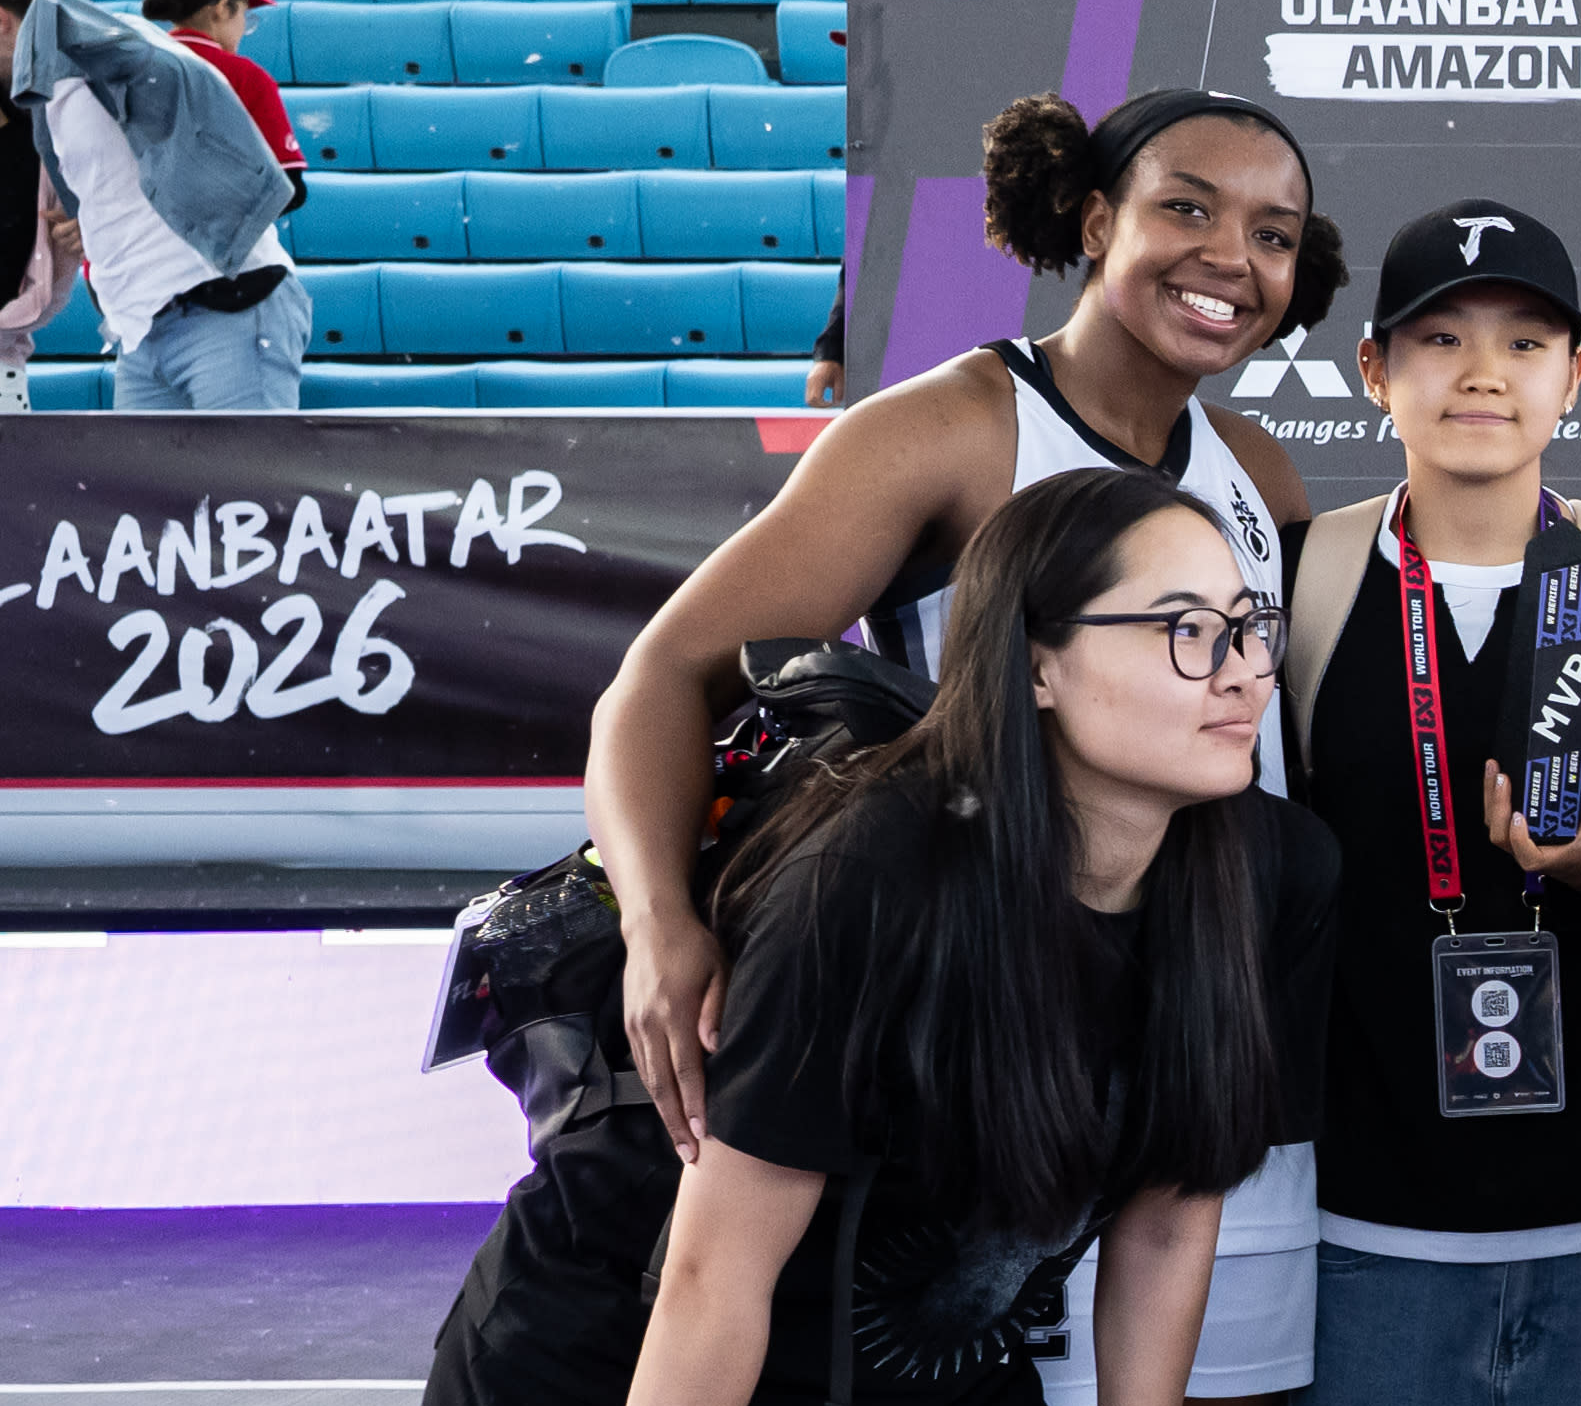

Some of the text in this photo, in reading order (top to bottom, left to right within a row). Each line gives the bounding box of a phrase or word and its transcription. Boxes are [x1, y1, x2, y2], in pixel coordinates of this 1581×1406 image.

[91, 580, 416, 735] 2026
[1409, 598, 1425, 675] WORLD TOUR
[1422, 742, 1440, 821] WORLD TOUR
